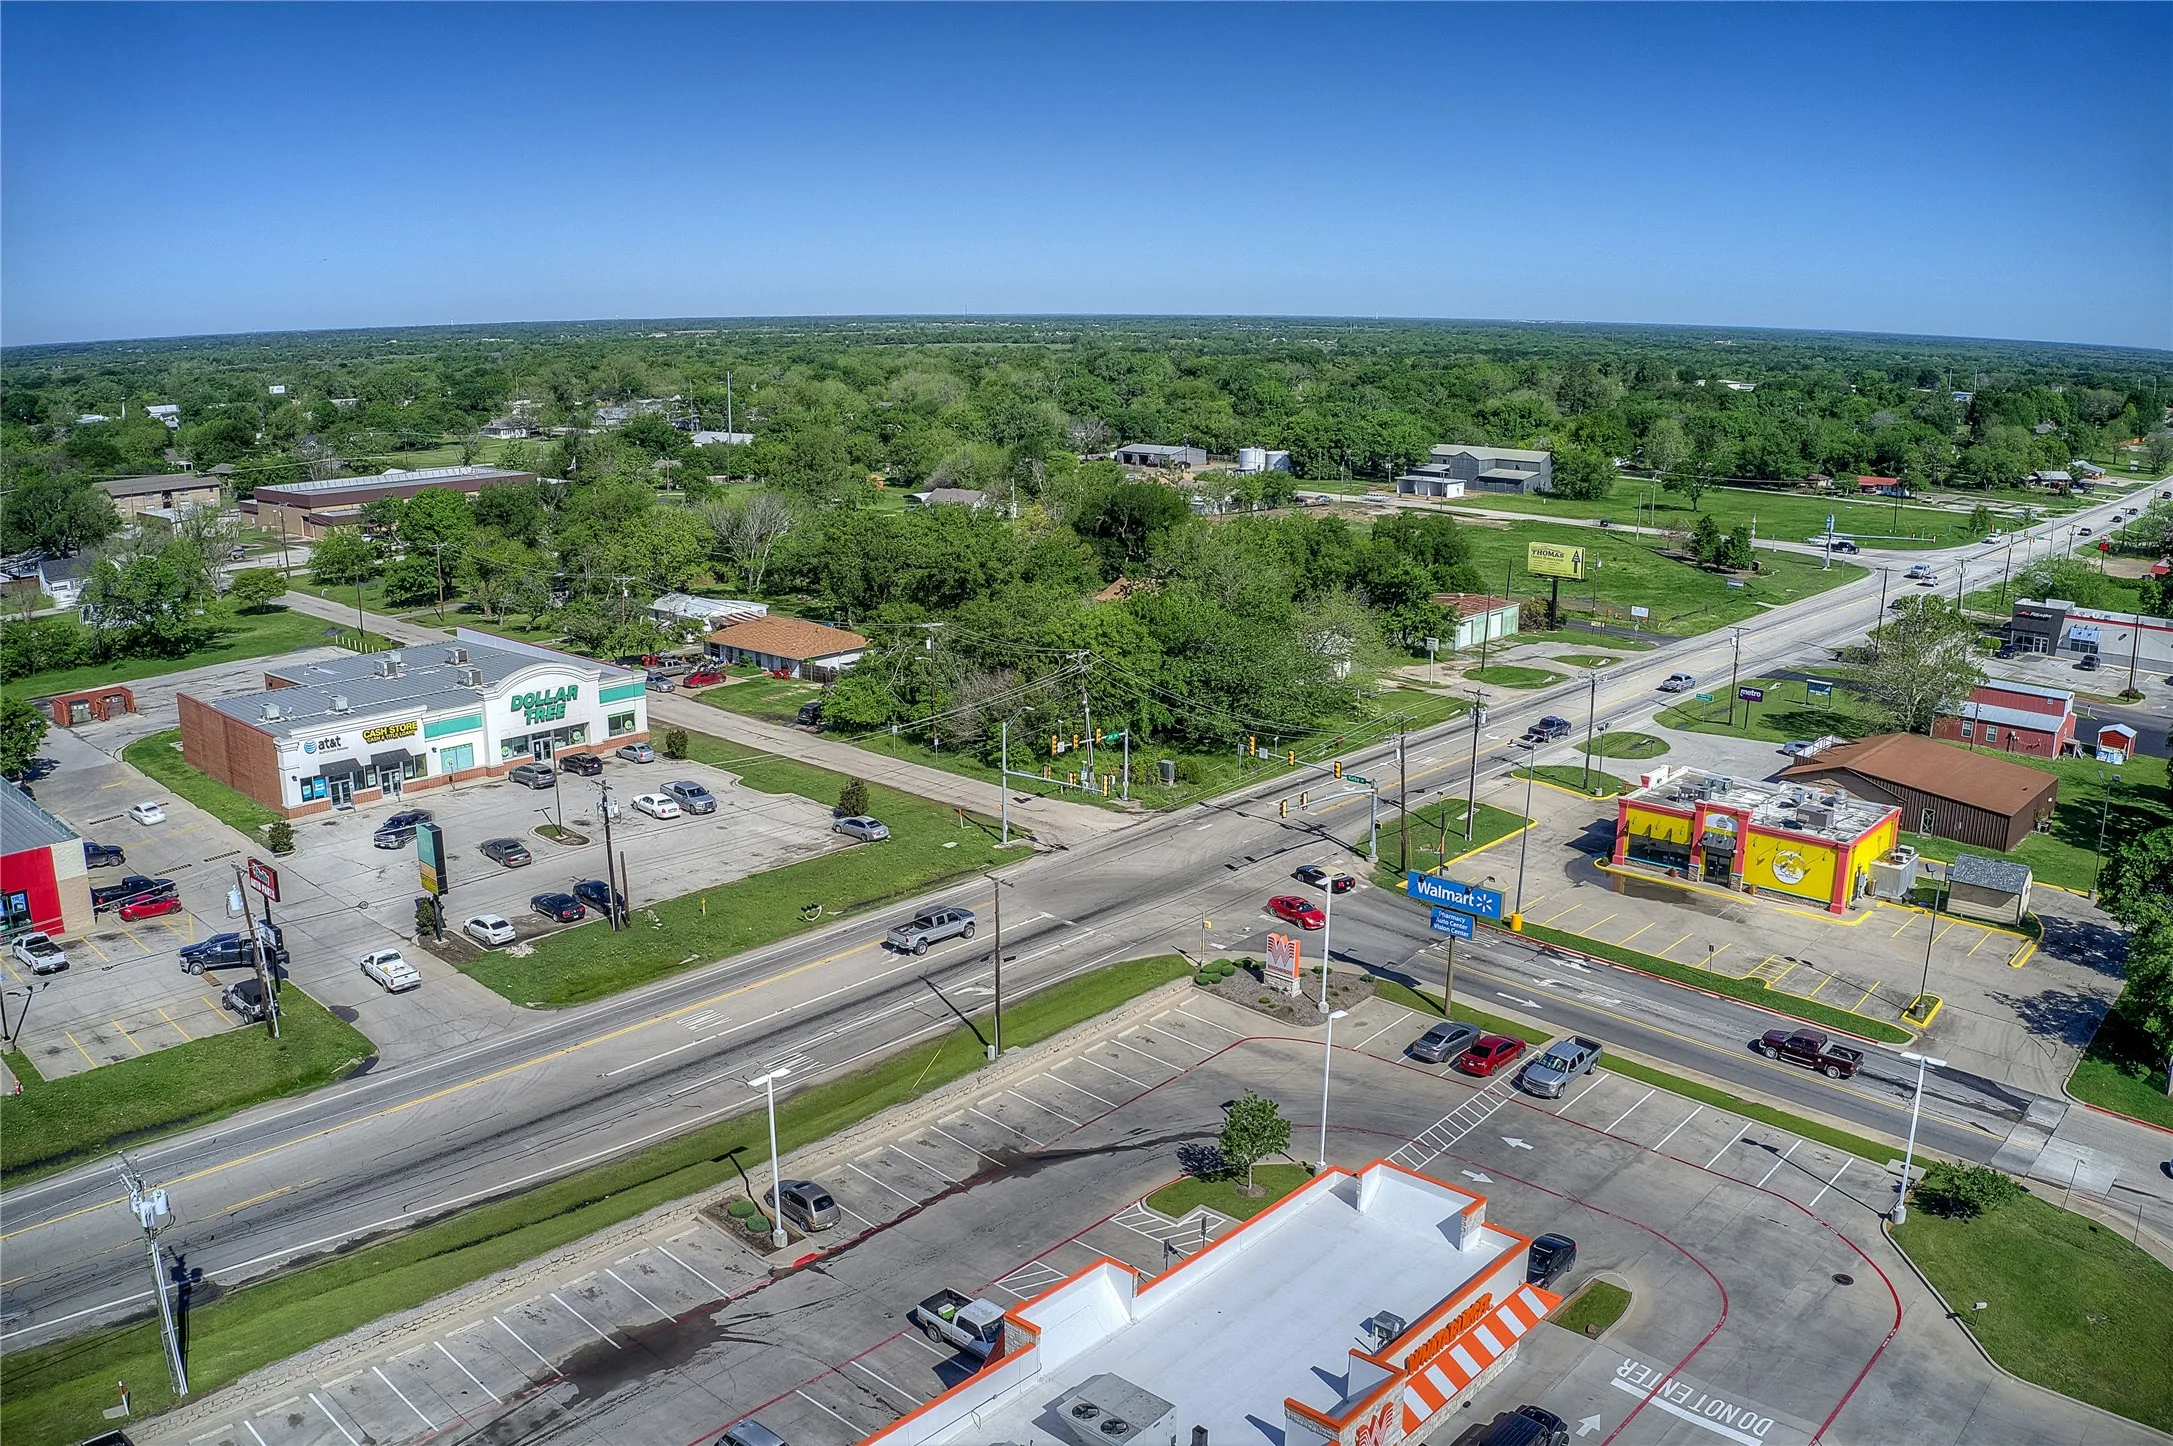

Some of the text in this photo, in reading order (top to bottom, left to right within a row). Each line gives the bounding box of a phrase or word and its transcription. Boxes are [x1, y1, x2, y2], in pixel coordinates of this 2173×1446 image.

[1532, 550, 1564, 558] THOMAS
[511, 685, 578, 712] DOLLAR
[1741, 689, 1761, 698] metro
[524, 703, 566, 725] TREE
[363, 721, 418, 739] CASH STORE
[318, 736, 342, 750] at&t
[1417, 881, 1474, 906] Walmart
[1436, 917, 1468, 930] Auto Center
[1438, 911, 1466, 923] Pharmacy
[1433, 923, 1469, 938] Vision Center
[1405, 1292, 1492, 1375] WHATABURGER
[1615, 1358, 1774, 1437] DO NOT ENTER
